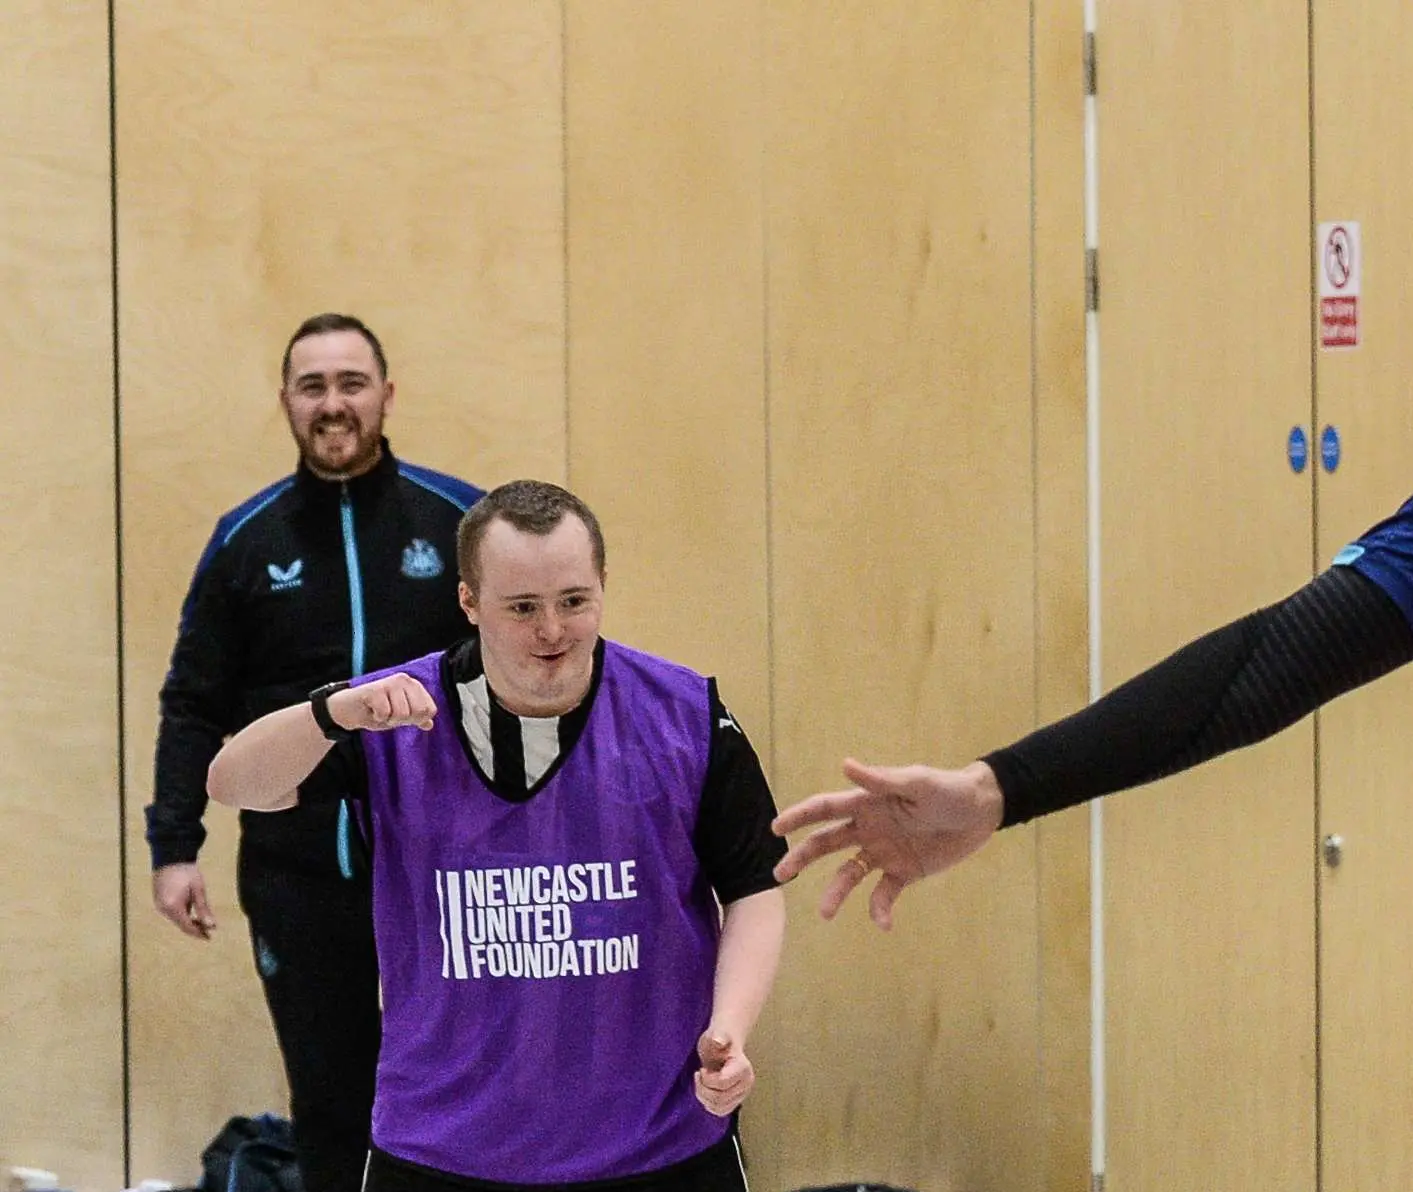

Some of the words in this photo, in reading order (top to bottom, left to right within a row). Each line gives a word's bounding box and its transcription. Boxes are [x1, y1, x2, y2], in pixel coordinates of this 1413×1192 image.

[464, 860, 638, 907] NEWCASTLE
[466, 903, 572, 944] UNITED
[469, 934, 639, 979] FOUNDATION
